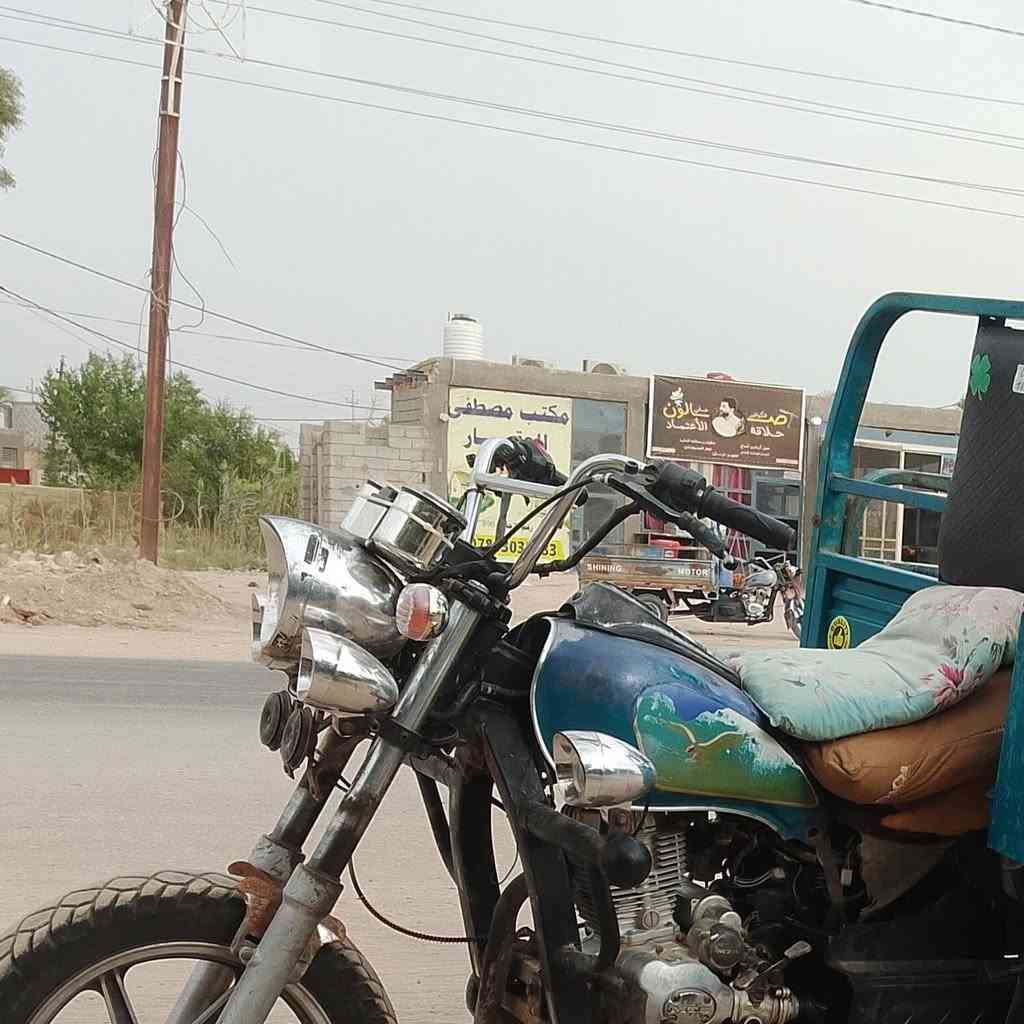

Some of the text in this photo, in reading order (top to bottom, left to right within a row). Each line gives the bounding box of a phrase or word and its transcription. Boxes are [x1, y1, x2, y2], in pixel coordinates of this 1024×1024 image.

[448, 397, 569, 426] مكتب مصطفى
[586, 563, 709, 577] SHINING MOTOR
